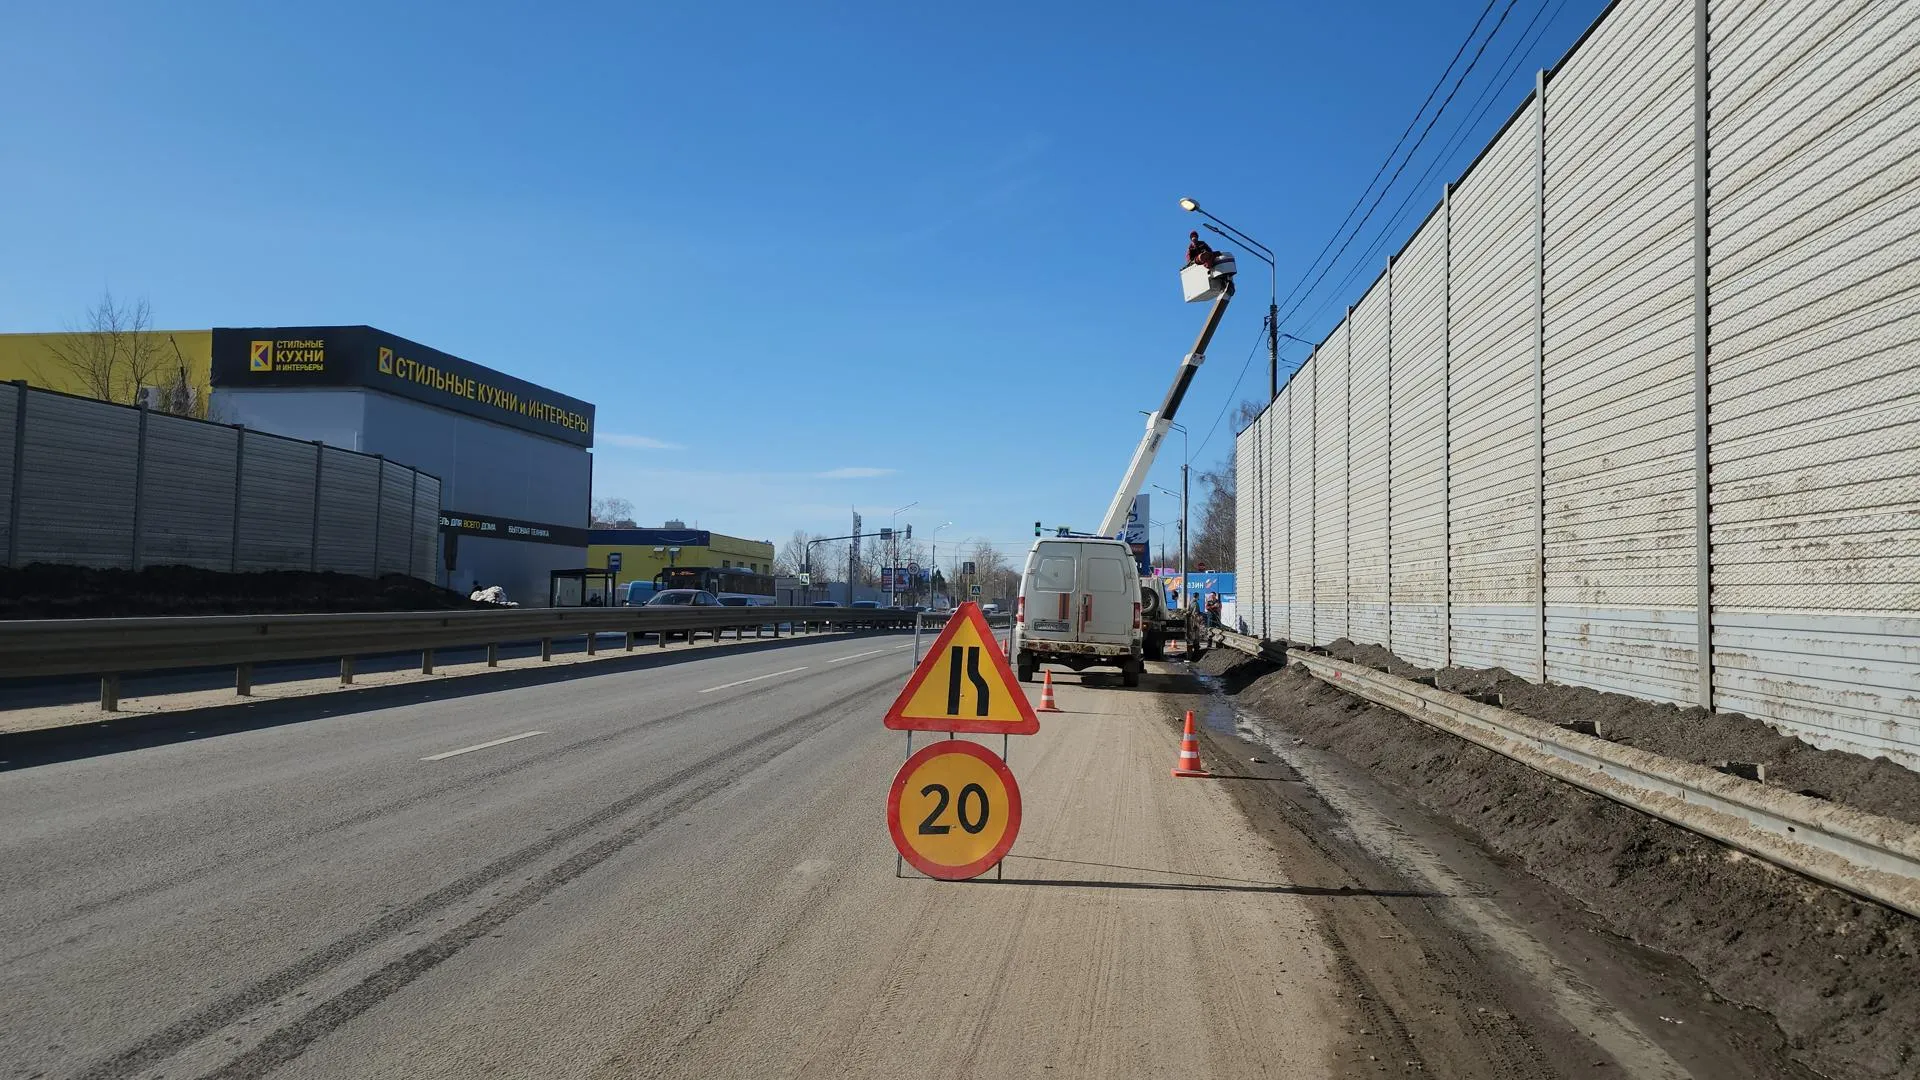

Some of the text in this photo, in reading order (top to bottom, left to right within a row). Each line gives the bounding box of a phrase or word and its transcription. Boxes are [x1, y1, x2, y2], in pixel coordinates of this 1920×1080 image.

[276, 340, 324, 348] СТИЛЬНЫЕ
[276, 350, 324, 362] КУХНИ
[396, 357, 475, 399] СТИЛЬНЫЕ
[478, 383, 518, 412] КУХНИ
[528, 399, 589, 433] ИНТЕРЬЕРЫ
[463, 520, 480, 529] ВСЕГО
[1174, 580, 1204, 589] Маазин
[918, 783, 990, 834] 20
